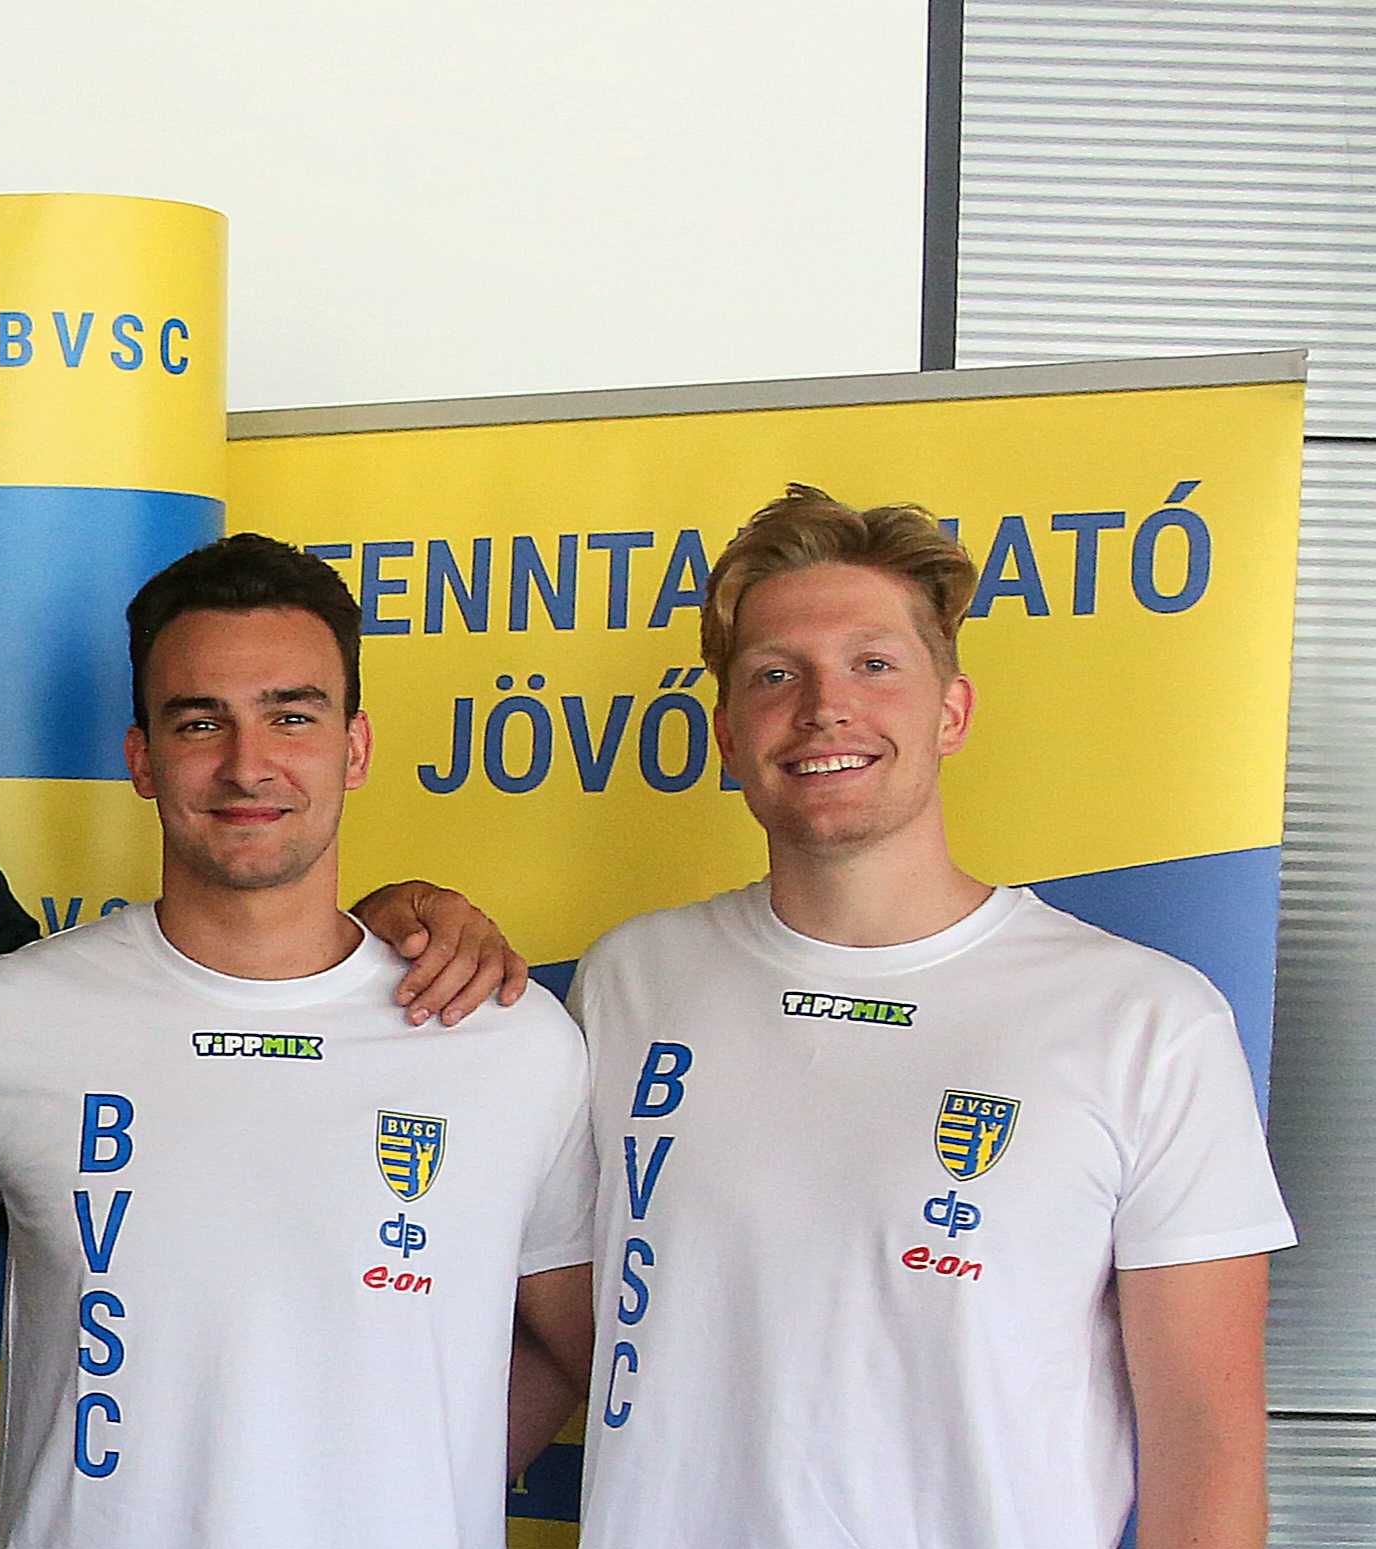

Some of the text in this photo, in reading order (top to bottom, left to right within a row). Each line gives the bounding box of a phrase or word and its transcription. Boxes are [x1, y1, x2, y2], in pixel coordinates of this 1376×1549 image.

[417, 667, 743, 793] JÖVŐ
[387, 1118, 435, 1138] BVSC
[952, 1096, 1006, 1117] BVSC
[72, 1092, 136, 1479] BVSC
[603, 1041, 695, 1429] BVSC
